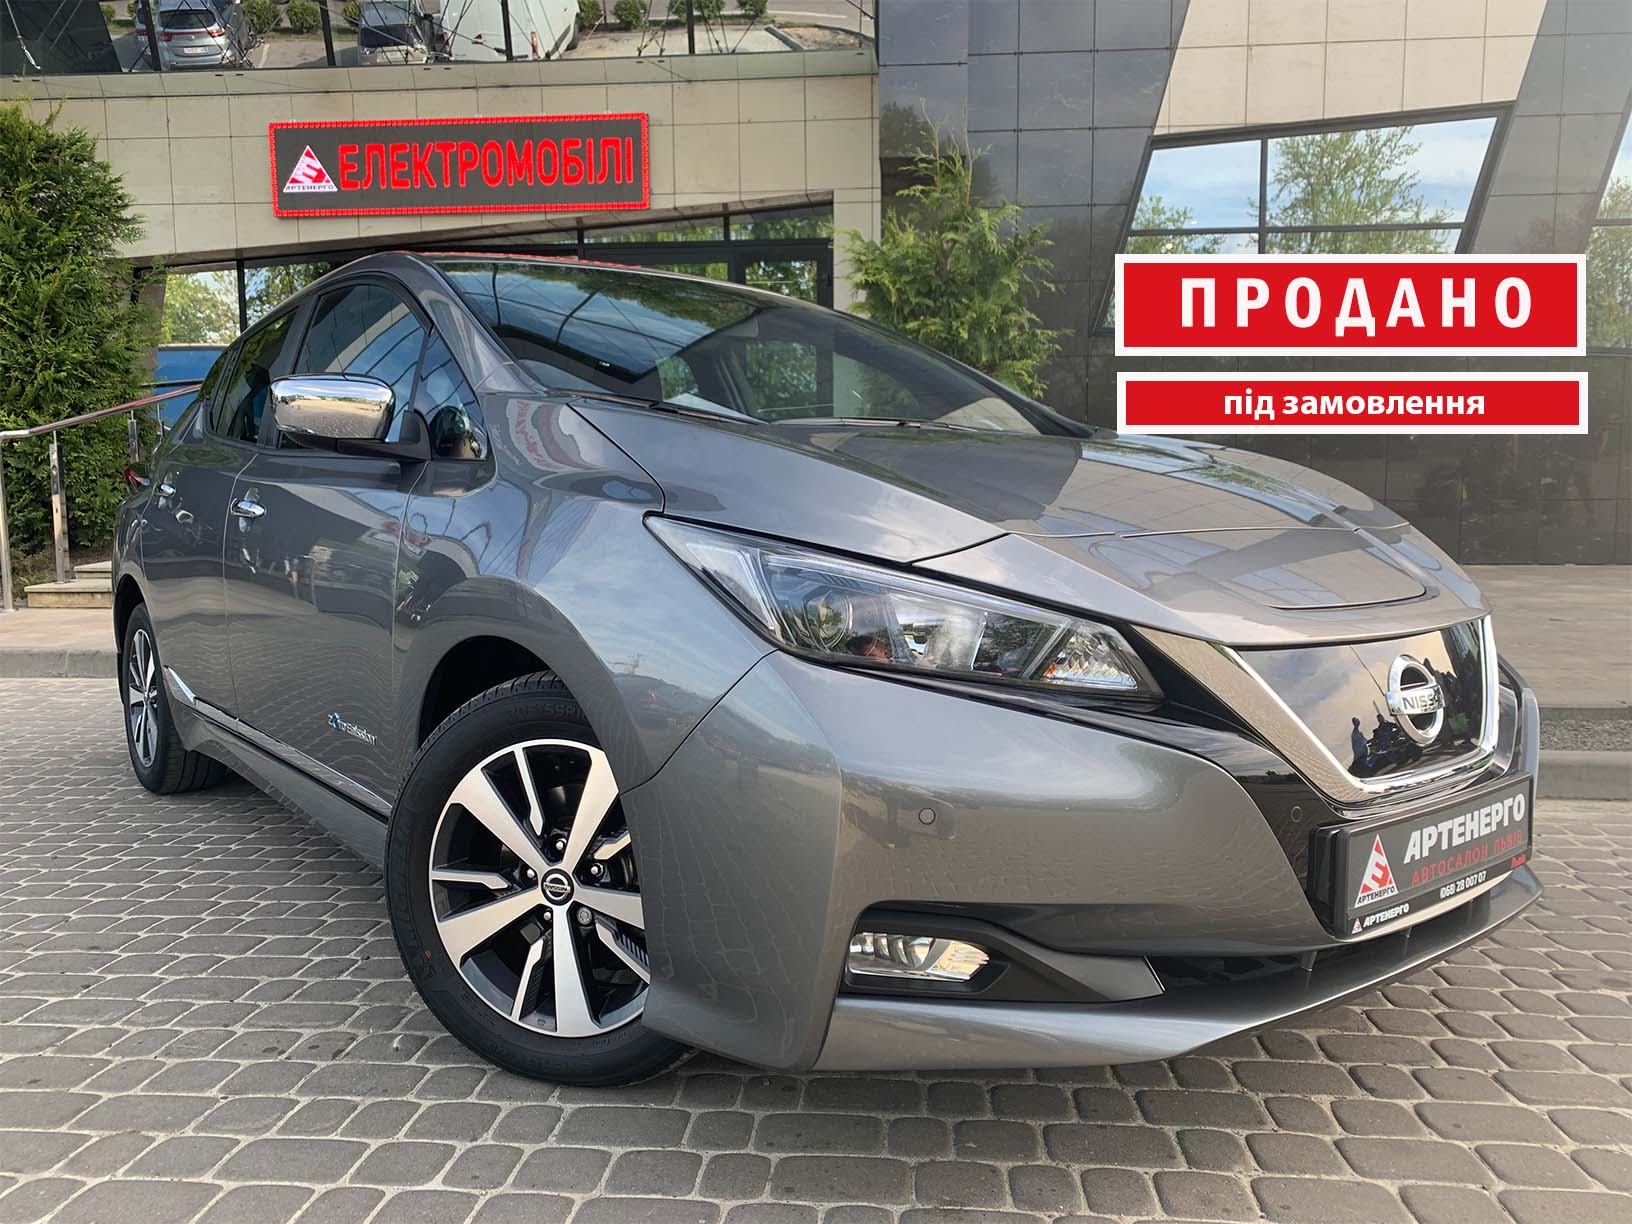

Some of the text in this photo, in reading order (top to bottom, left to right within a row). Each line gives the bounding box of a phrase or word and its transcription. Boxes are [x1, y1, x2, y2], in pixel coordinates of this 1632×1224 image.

[339, 137, 635, 190] ЕЛЕКТРОМОБІЛІ
[1402, 692, 1443, 710] NISS
[1404, 793, 1526, 864] АРТЕНЕРГО
[1412, 844, 1488, 885] АВТОСАЛОН
[1456, 879, 1465, 892] 28
[1465, 874, 1478, 888] 007
[1478, 870, 1487, 883] 07
[1357, 886, 1396, 905] АРТЕНЕРГО
[1363, 903, 1410, 928] АРТЕНЕРГО
